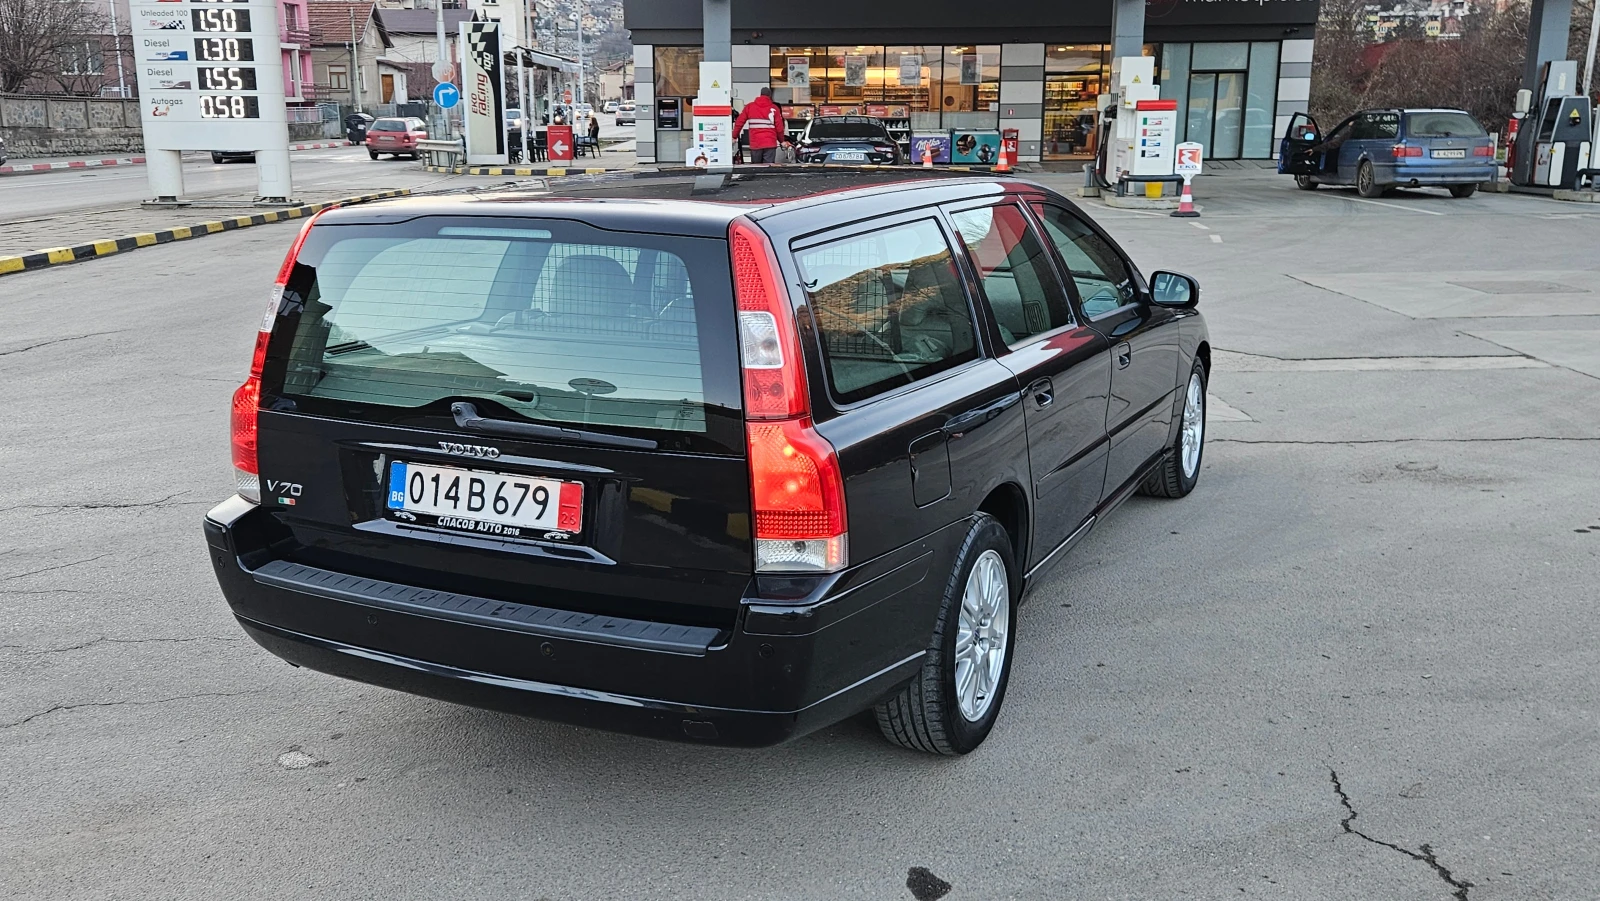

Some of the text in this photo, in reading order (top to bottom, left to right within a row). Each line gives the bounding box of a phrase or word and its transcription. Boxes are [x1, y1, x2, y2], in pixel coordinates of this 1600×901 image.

[140, 9, 188, 17] Unleaded 100
[199, 8, 237, 32] 1.50
[144, 39, 170, 47] Diesel
[202, 38, 240, 61] 1.30
[483, 51, 492, 72] 100
[147, 68, 173, 76] Diesel
[205, 67, 243, 90] 1.55
[151, 97, 183, 106] Autogas
[477, 72, 488, 117] racing
[199, 95, 245, 118] 0.58
[438, 441, 500, 459] VOLVO
[267, 479, 303, 497] V70
[391, 490, 404, 502] BG
[437, 515, 520, 536] СПАСОВ АУТО 2016
[561, 511, 577, 526] 26
